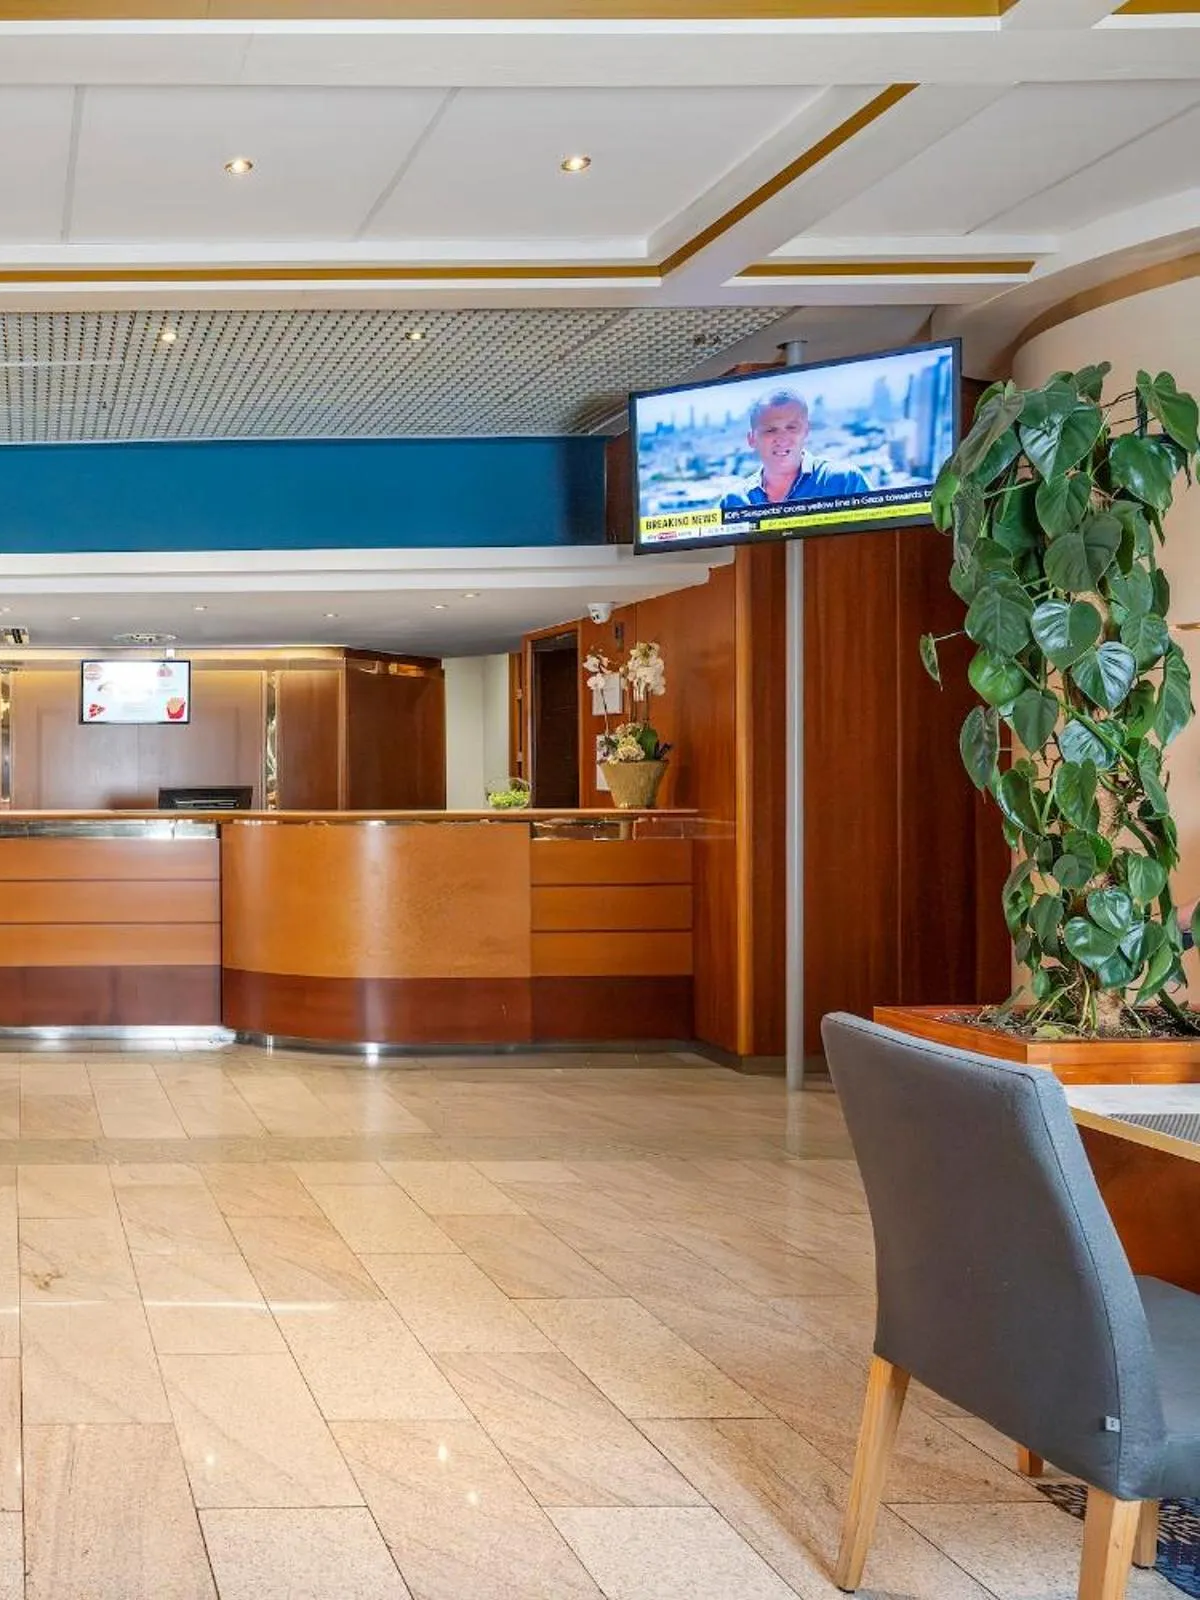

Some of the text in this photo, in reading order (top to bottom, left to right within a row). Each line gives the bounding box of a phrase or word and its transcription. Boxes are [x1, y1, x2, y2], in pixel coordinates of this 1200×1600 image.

[783, 503, 806, 513] cross
[807, 500, 834, 512] yellow
[835, 498, 850, 507] line
[861, 494, 883, 505] Gaza
[885, 490, 923, 502] towards
[645, 516, 689, 530] BREAKING
[692, 512, 718, 525] NEWS
